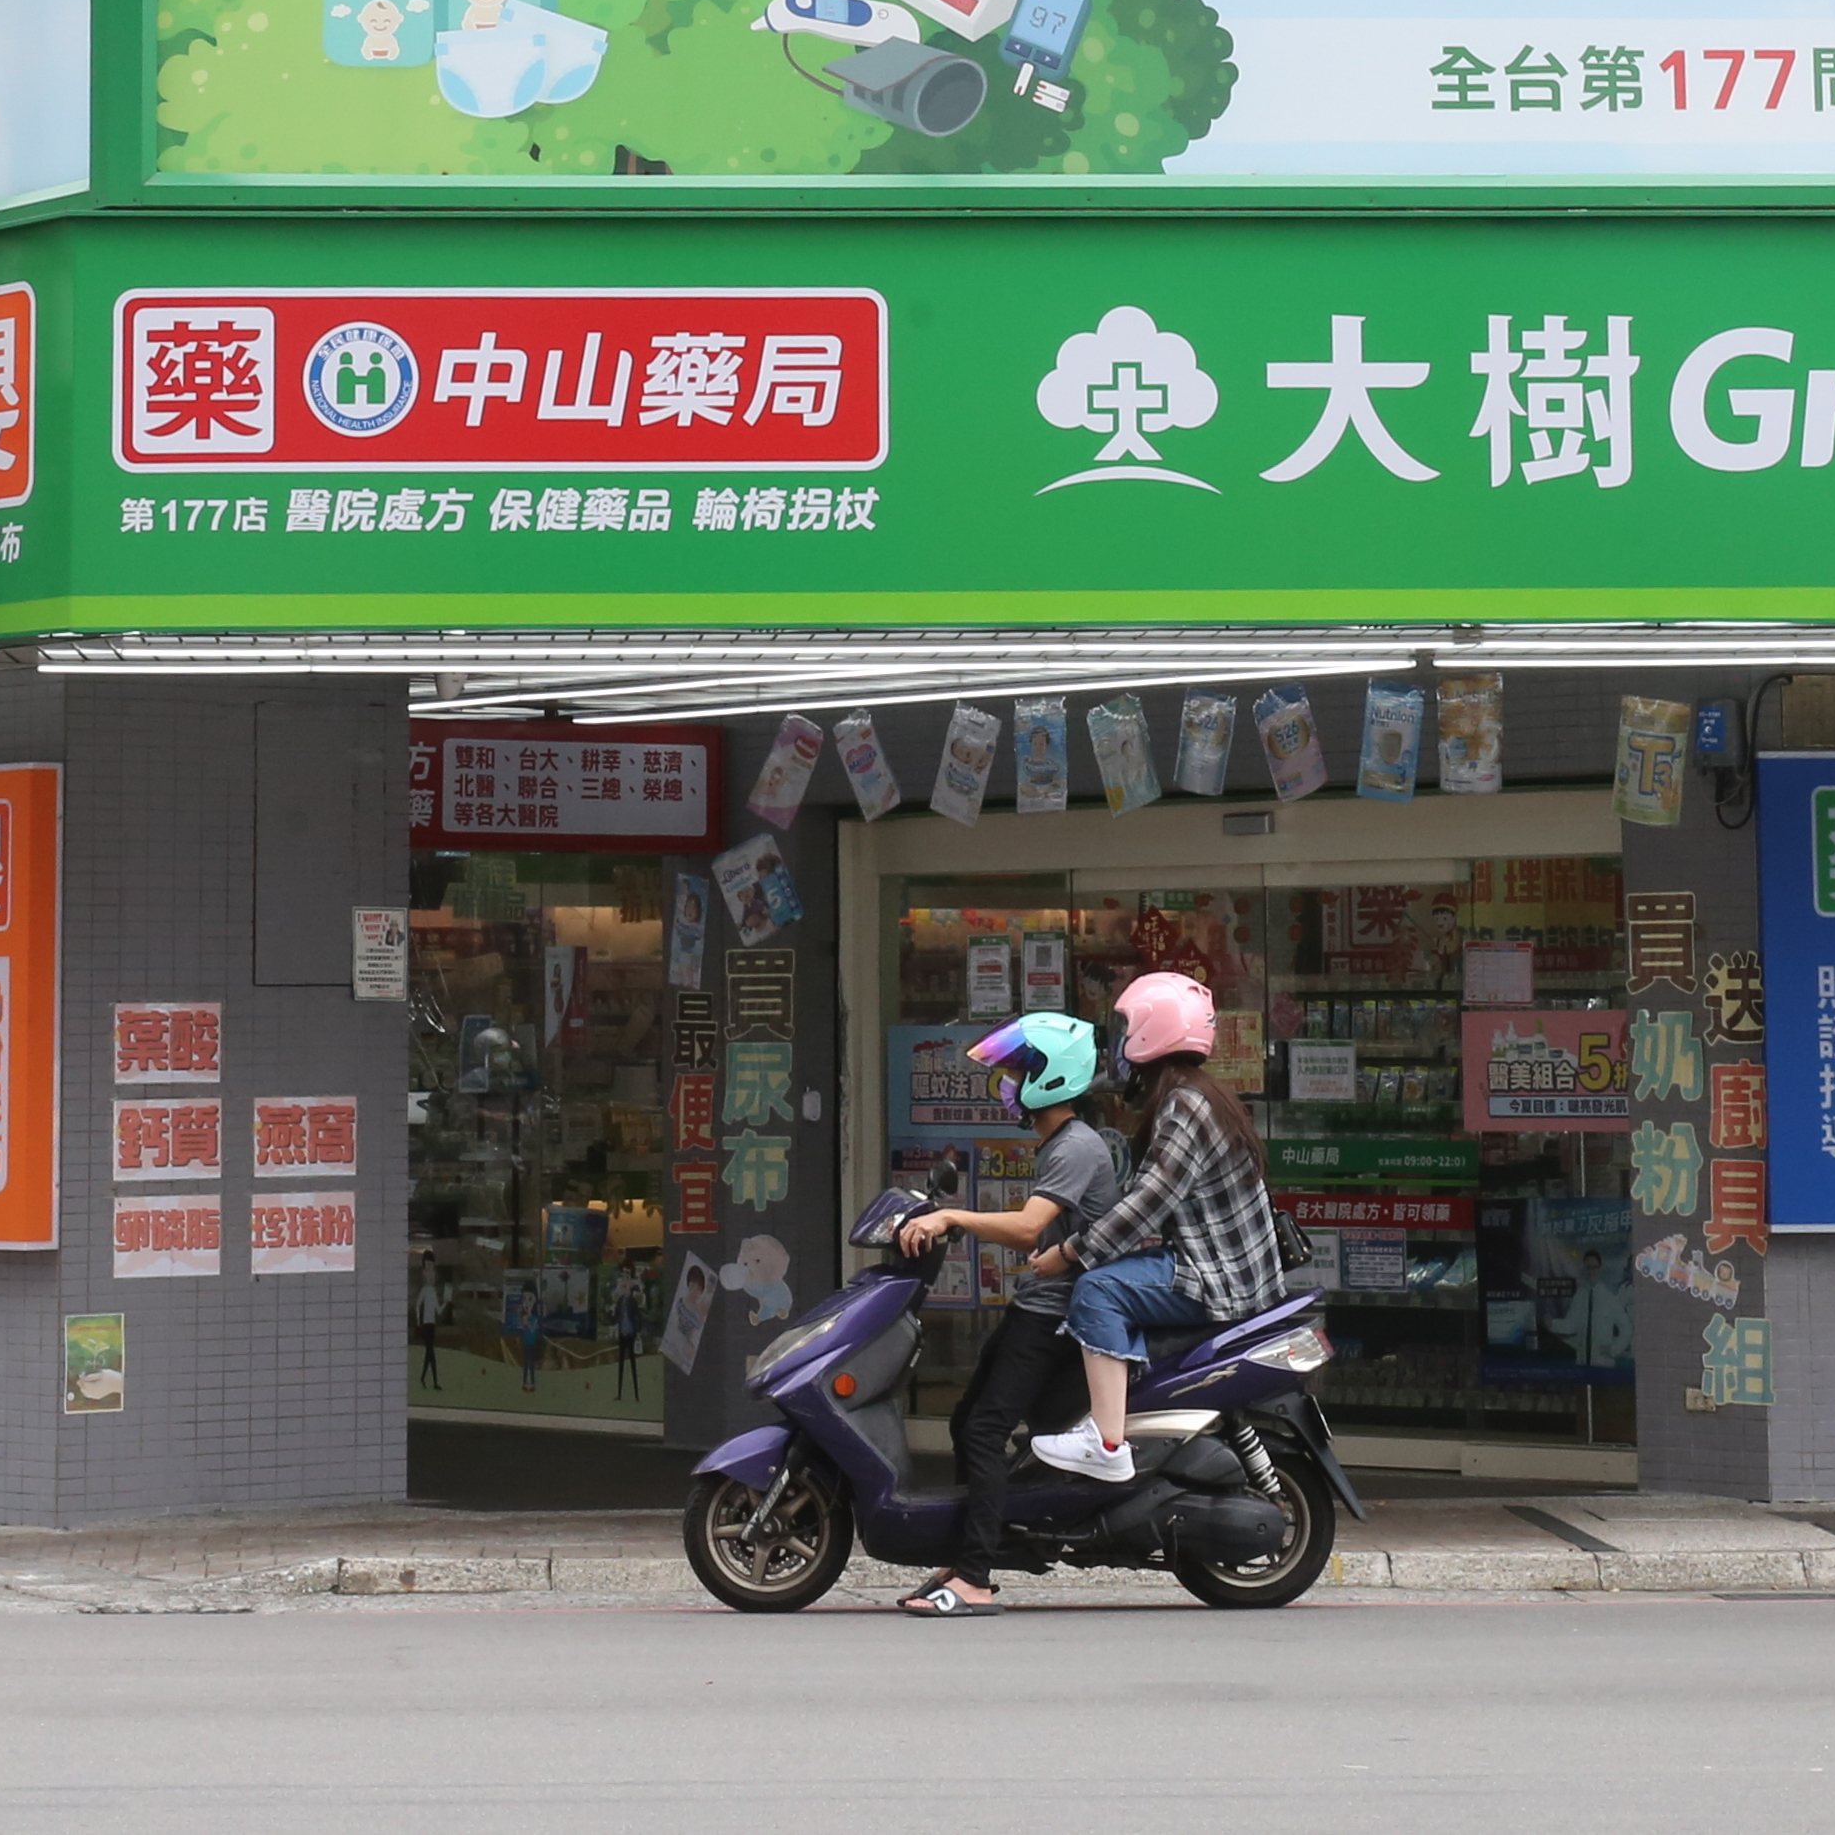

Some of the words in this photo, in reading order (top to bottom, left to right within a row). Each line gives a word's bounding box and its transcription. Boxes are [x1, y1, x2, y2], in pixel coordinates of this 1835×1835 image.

[1029, 6, 1068, 36] 97
[143, 321, 262, 441] 藥
[311, 379, 337, 424] NATIONAL
[337, 416, 376, 430] HEALTH
[375, 380, 413, 426] INSURANCE
[433, 330, 845, 431] 中山藥局
[1258, 312, 1642, 490] 大樹
[119, 496, 269, 534] 第177店
[284, 487, 476, 535] 醫院處方
[487, 487, 672, 534] 保健藥品
[691, 487, 881, 534] 輪椅拐杖
[453, 802, 560, 829] 等各大醫院
[115, 1009, 221, 1074] 葉酸
[1626, 891, 1704, 1216] 買奶粉
[722, 948, 796, 1212] 買尿布
[116, 1106, 221, 1170] 鈣質
[254, 1104, 355, 1167] 燕窩
[669, 991, 719, 1234] 最便宜
[1281, 1146, 1341, 1167] 中山藥局
[114, 1206, 221, 1254] 卵磷脂
[251, 1204, 355, 1251] 珍珠粉
